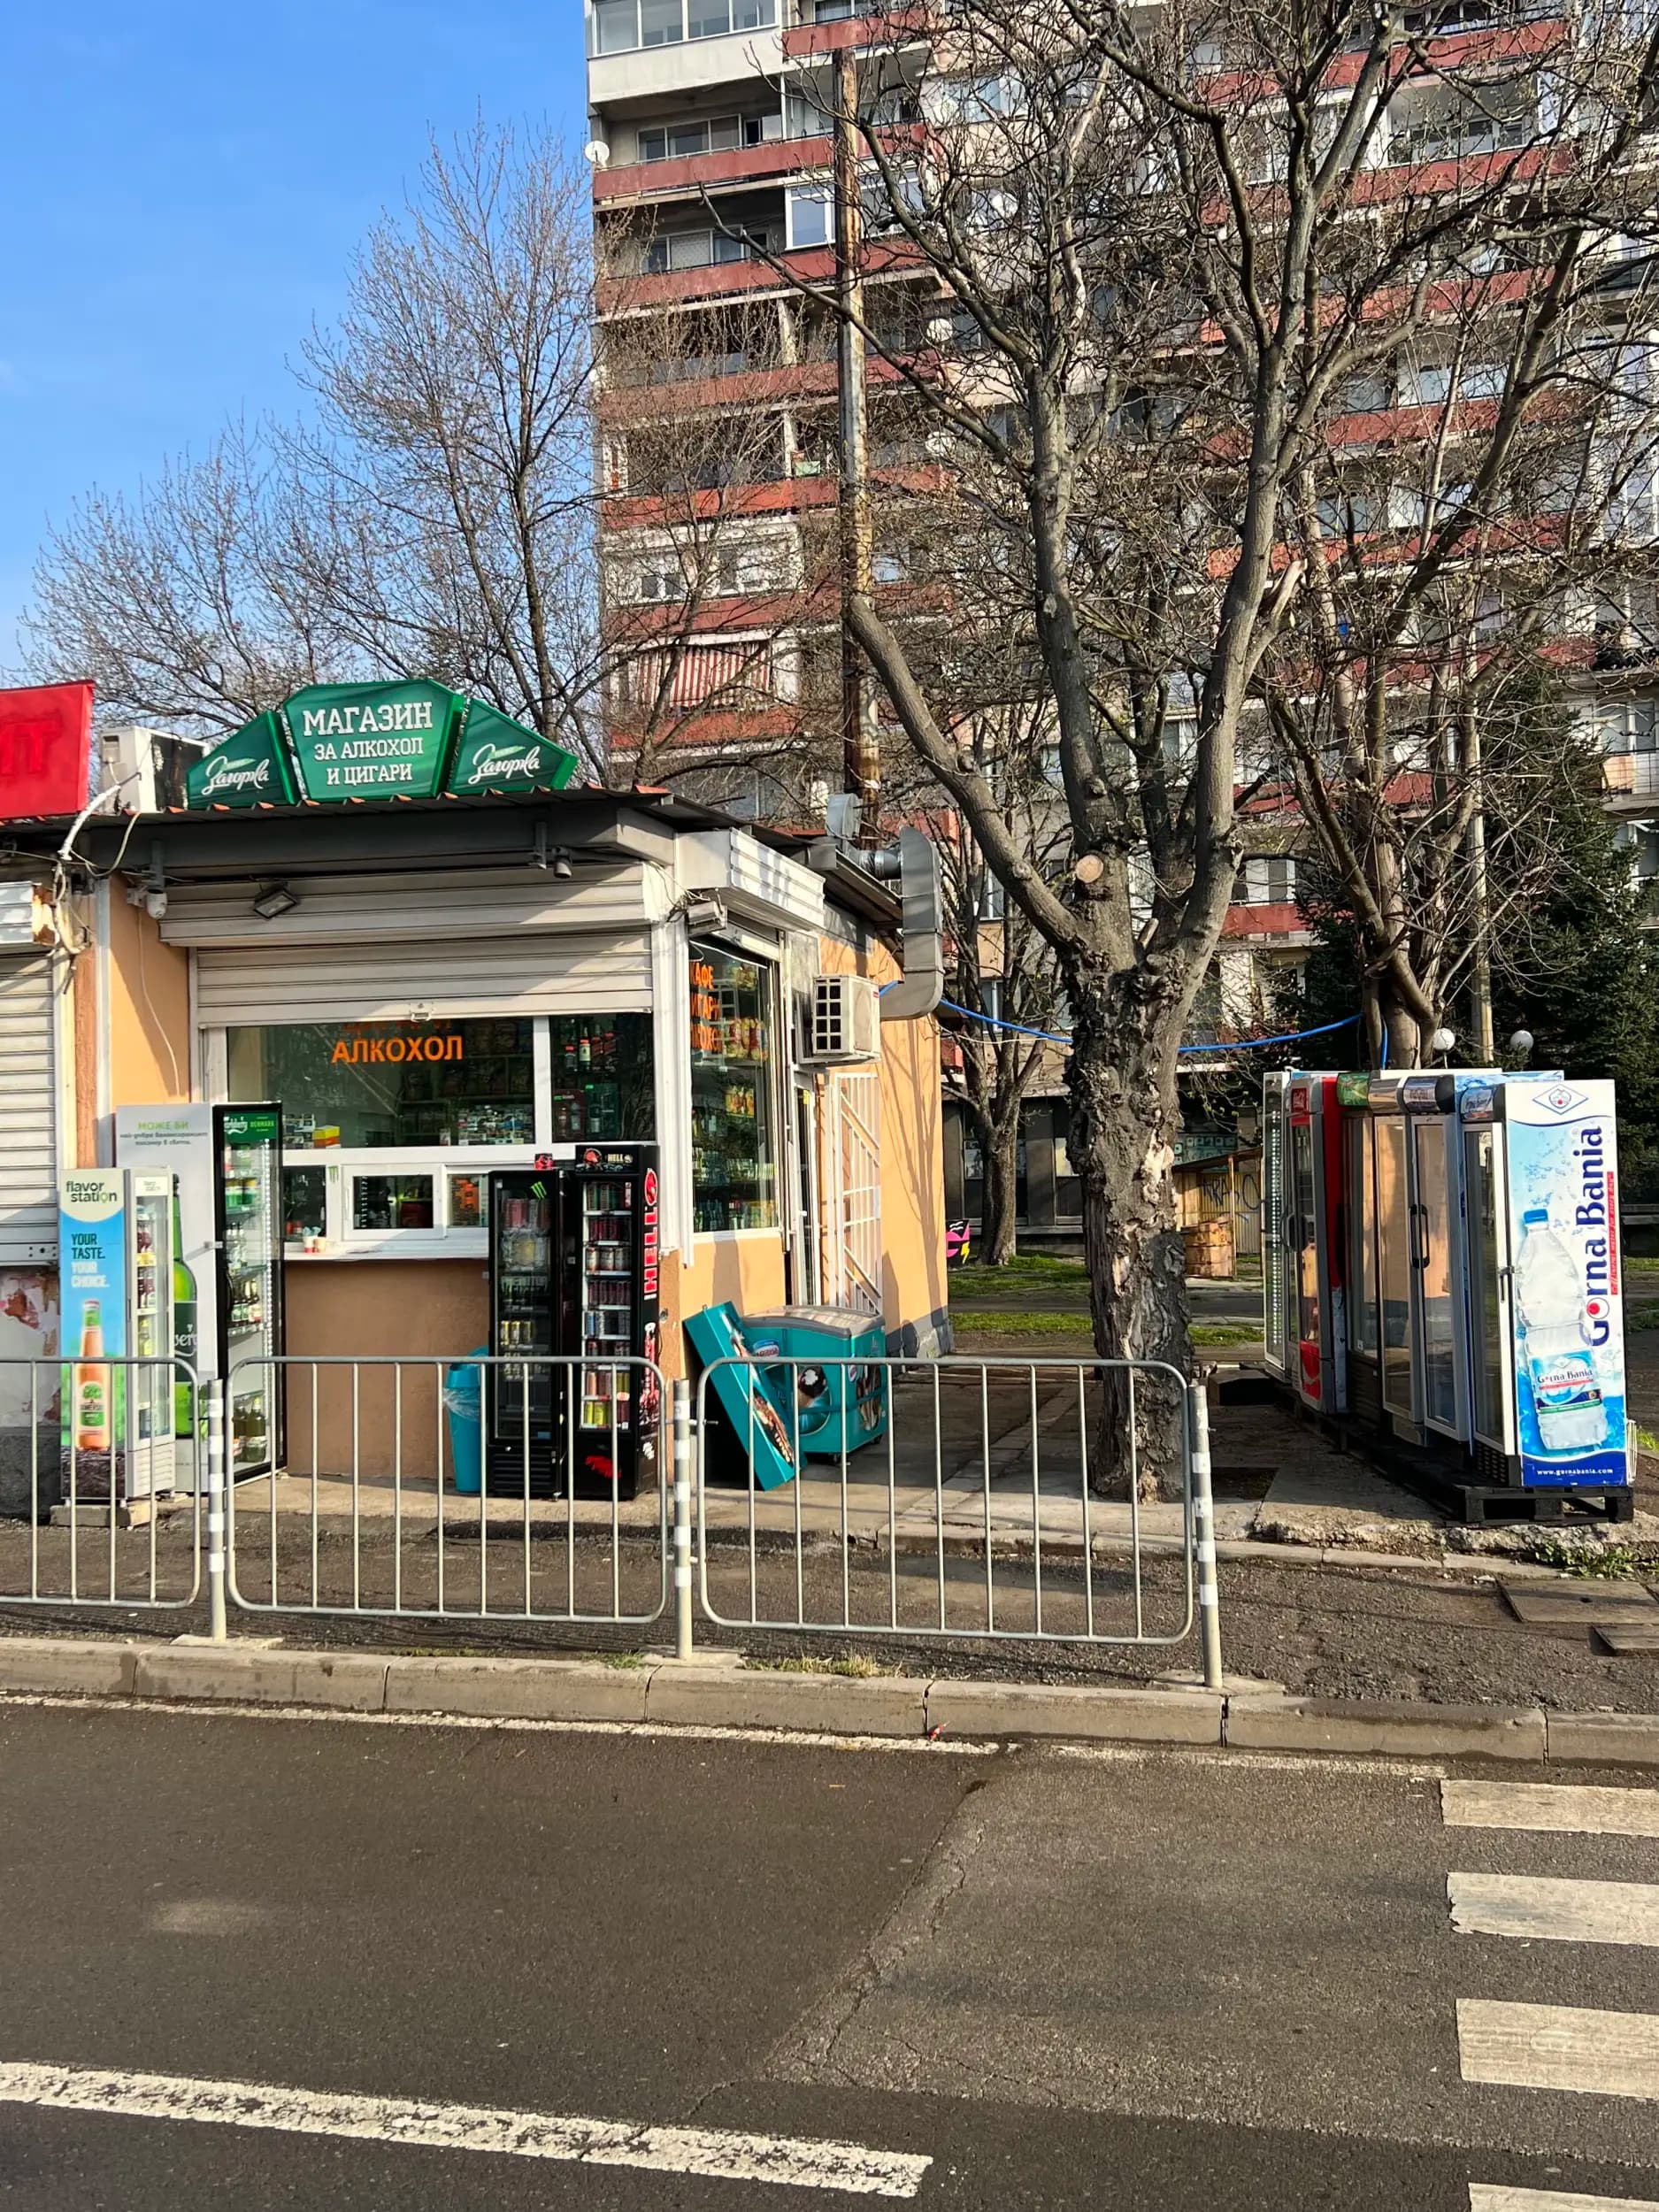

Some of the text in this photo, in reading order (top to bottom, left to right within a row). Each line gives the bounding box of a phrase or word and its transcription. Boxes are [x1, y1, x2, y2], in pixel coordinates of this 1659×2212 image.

[303, 702, 434, 736] МАГАЗИН
[314, 737, 424, 761] ЗА АЛКОХОЛ
[201, 755, 271, 796] Загорка
[326, 764, 412, 786] И ЦИГАРИ
[466, 743, 541, 786] Загорка
[332, 1035, 463, 1064] АЛКОХОЛ
[608, 1153, 624, 1163] HELL
[66, 1180, 105, 1193] flavor
[71, 1192, 118, 1203] station
[71, 1233, 97, 1246] YOUR
[1573, 1125, 1610, 1347] Gorna Bania
[72, 1247, 106, 1259] TASTE.
[644, 1205, 658, 1294] HELL
[71, 1261, 98, 1274] YOUR
[1567, 1368, 1594, 1380] Bania
